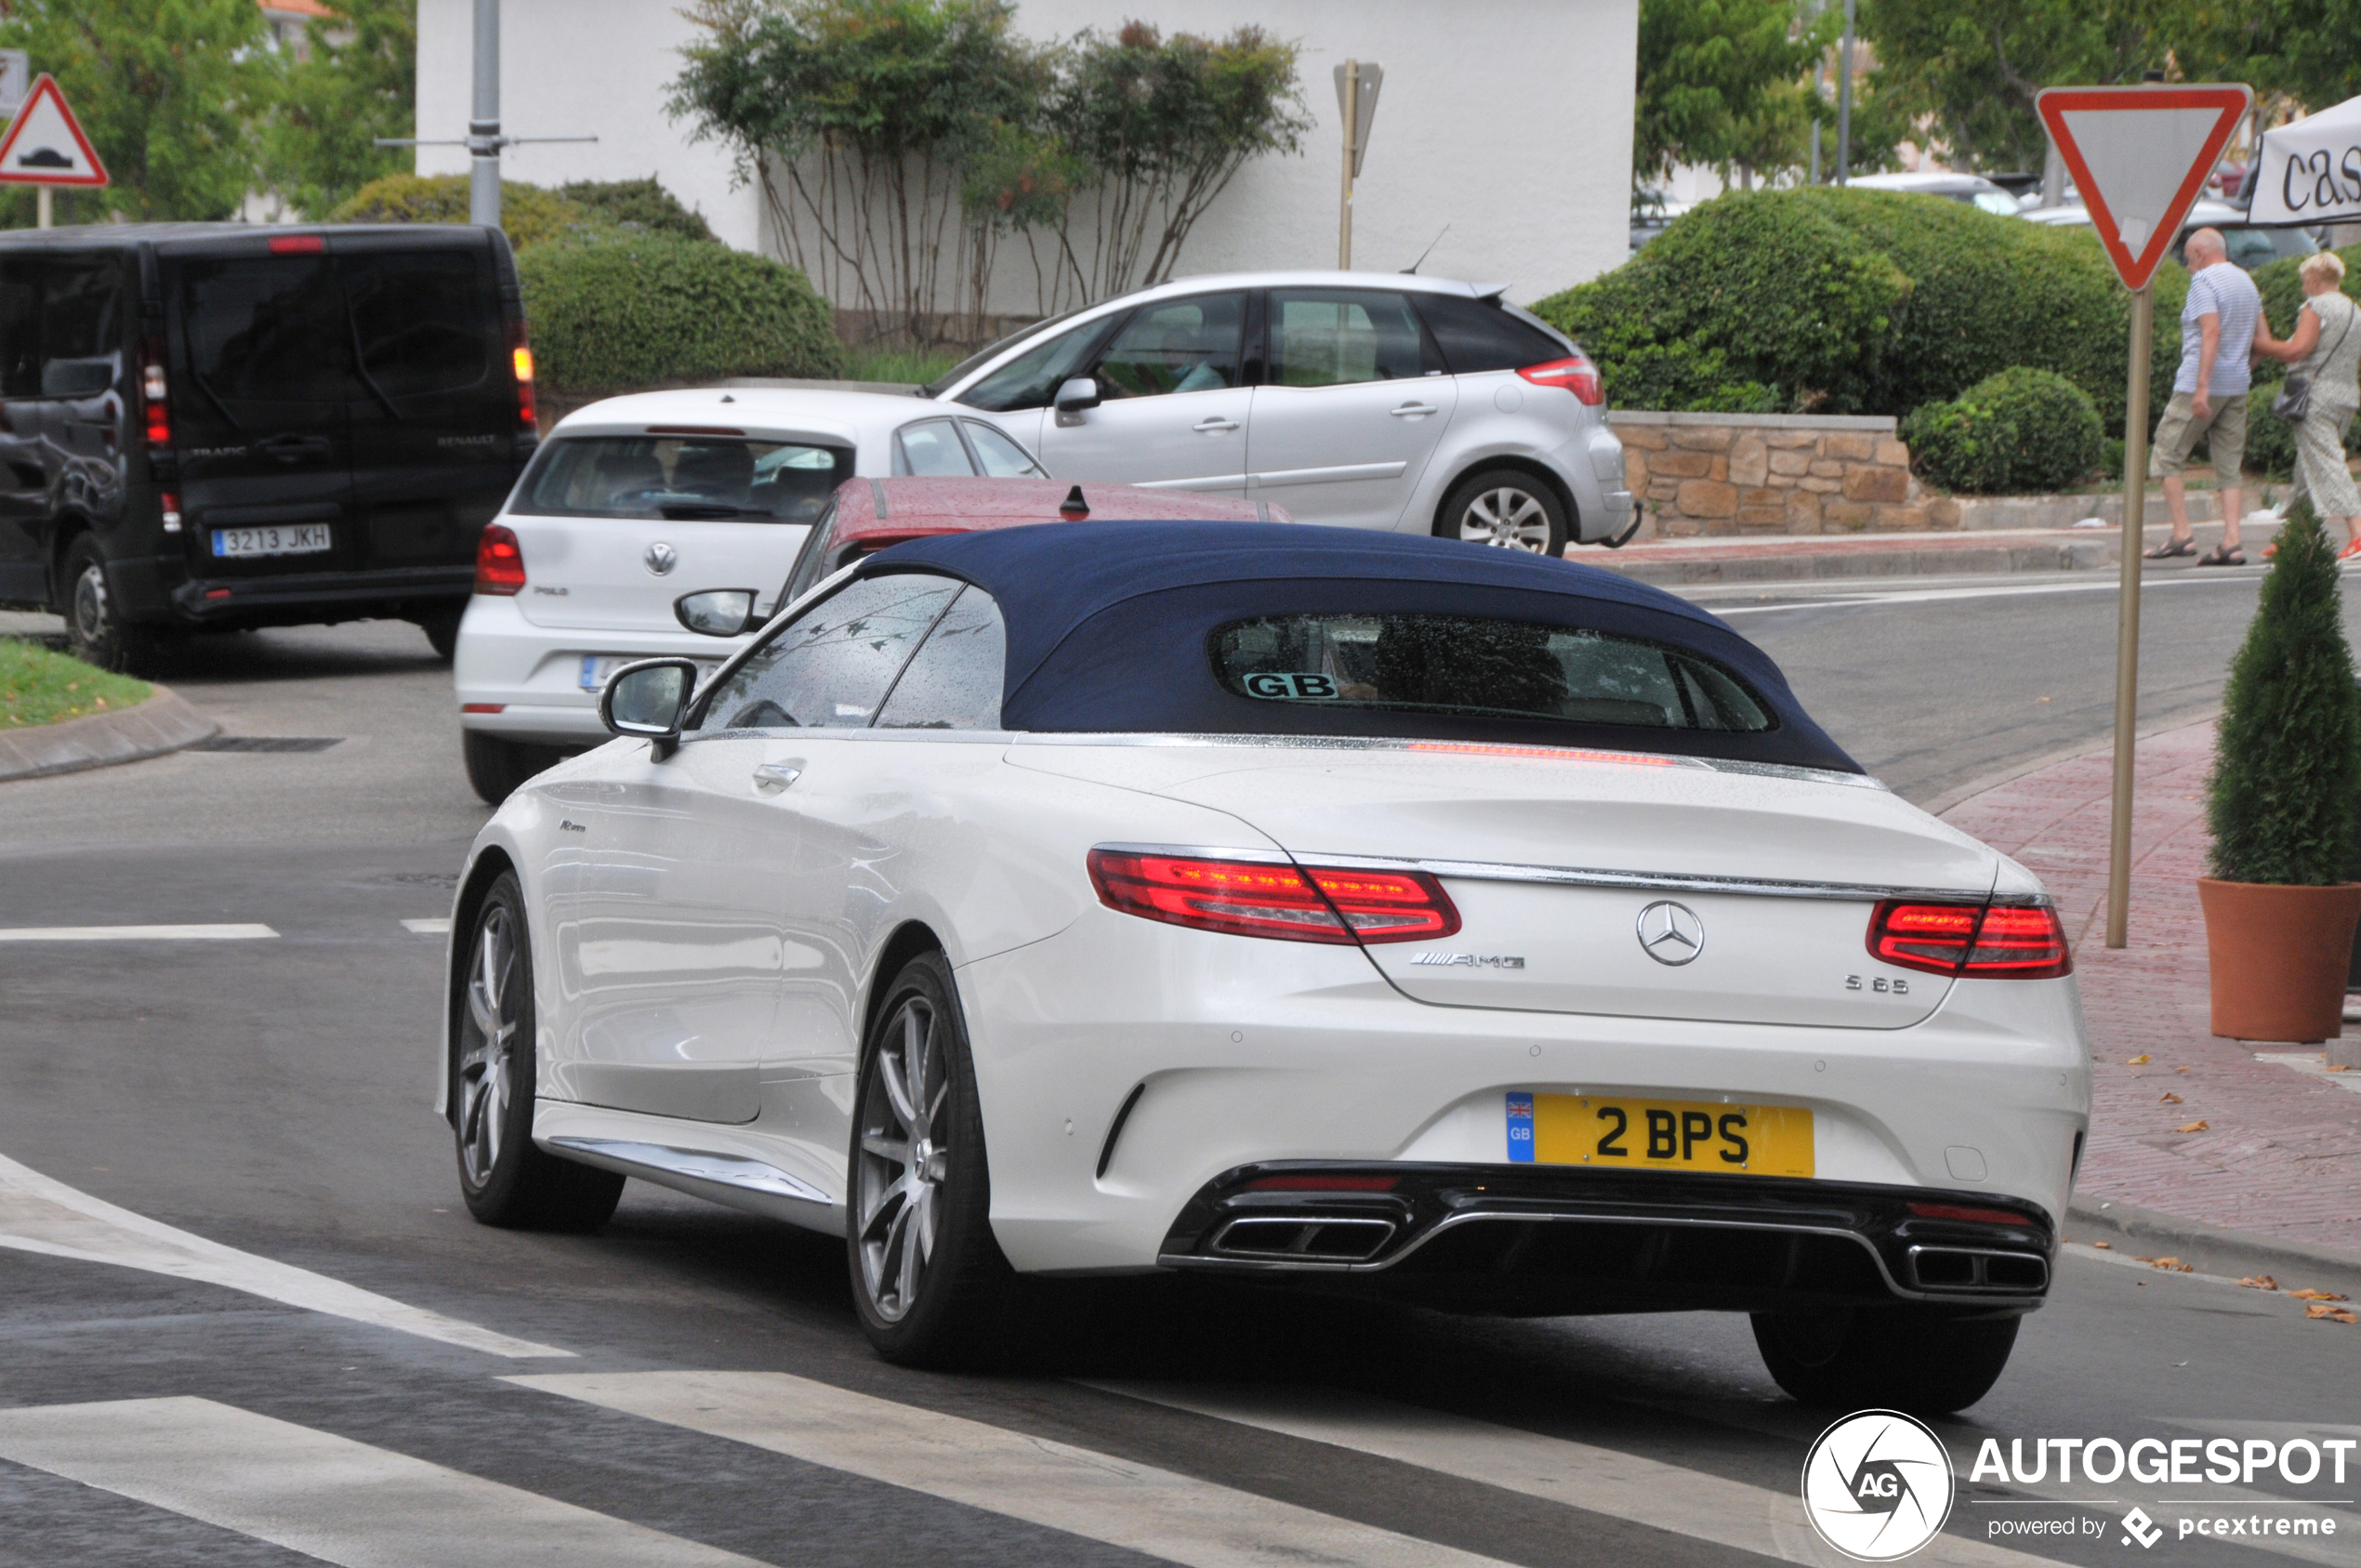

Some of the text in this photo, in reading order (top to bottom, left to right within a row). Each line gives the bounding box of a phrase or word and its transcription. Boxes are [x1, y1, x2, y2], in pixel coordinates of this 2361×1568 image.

[228, 527, 325, 551] 3213 JKH
[1247, 674, 1335, 697] GB
[1844, 974, 1908, 995] S 65
[1510, 1127, 1531, 1140] GB
[1596, 1106, 1748, 1163] 2 BPS
